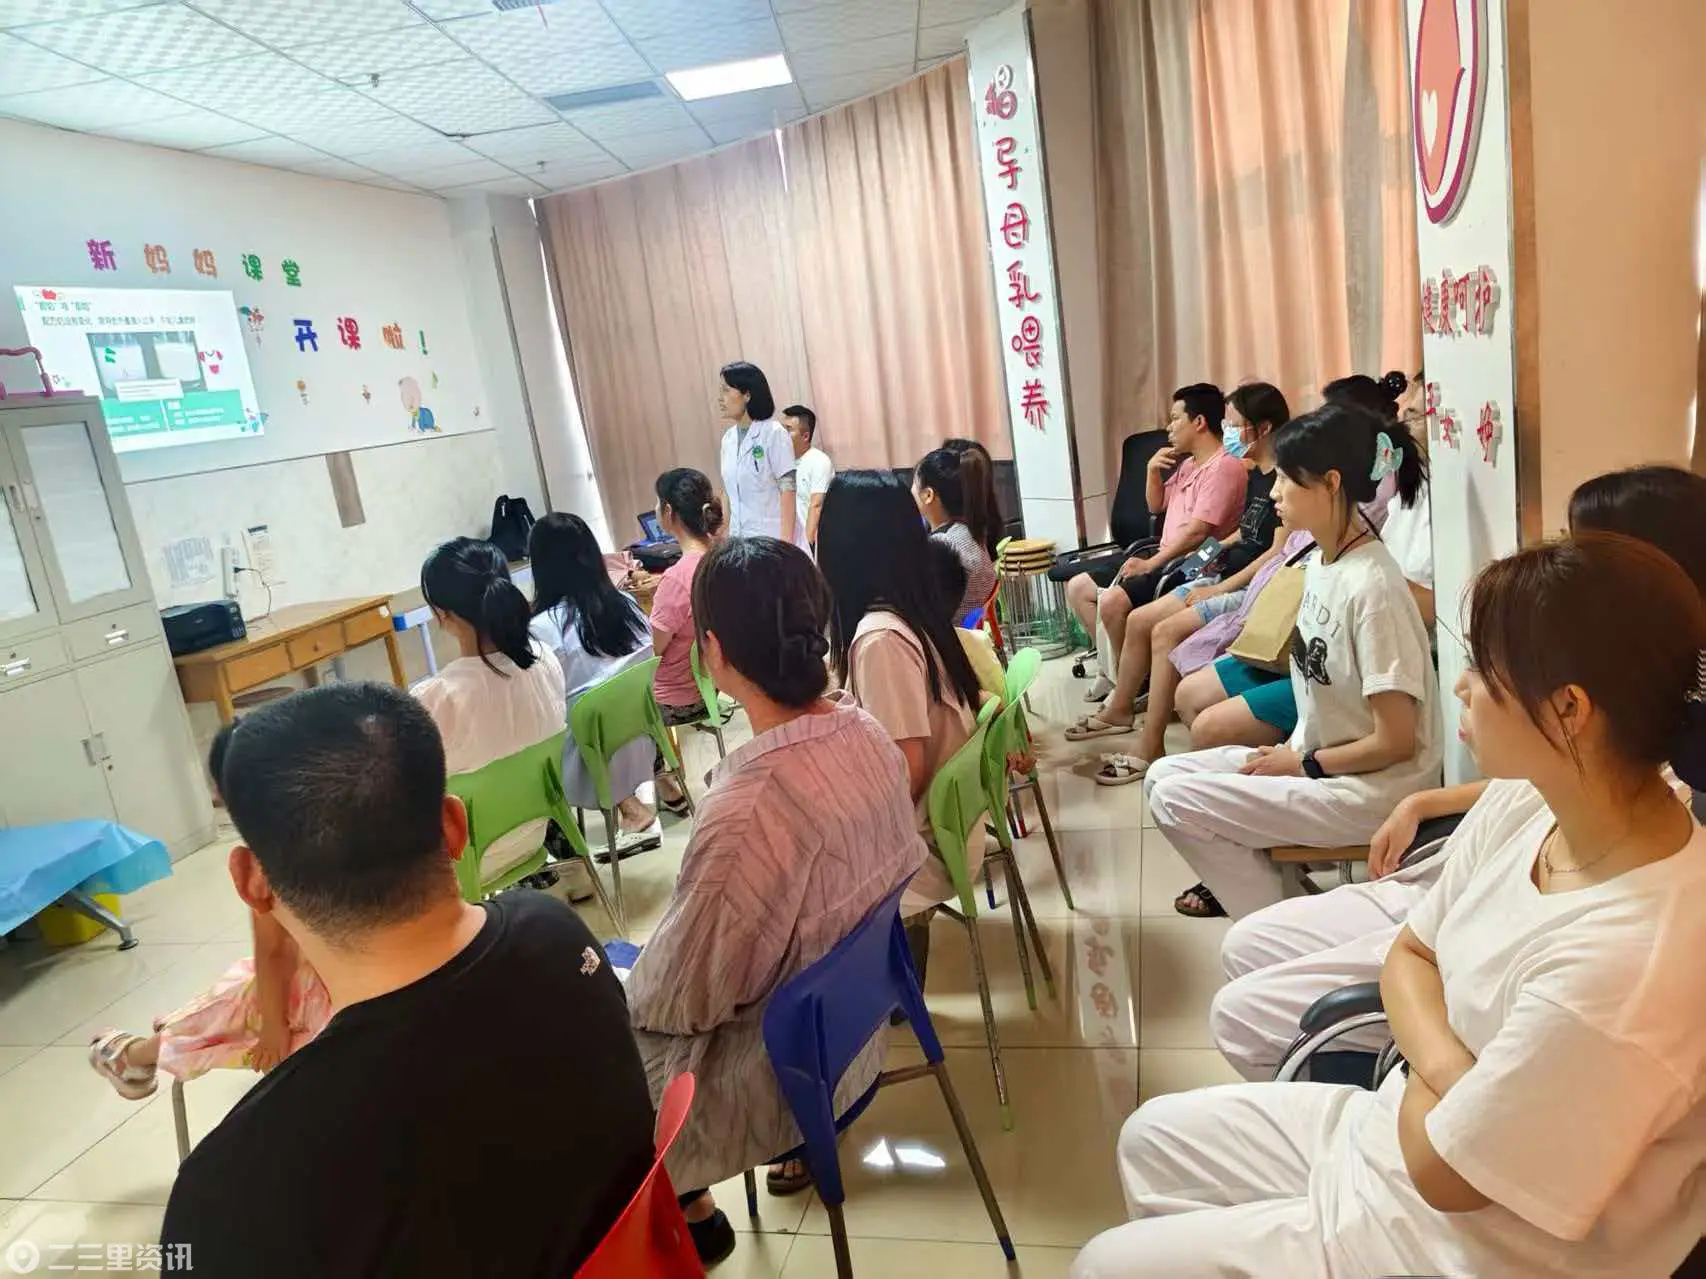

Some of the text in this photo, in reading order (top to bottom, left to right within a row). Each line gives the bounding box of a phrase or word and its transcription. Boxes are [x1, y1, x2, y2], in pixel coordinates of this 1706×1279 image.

[86, 238, 302, 288] 新妈妈课堂
